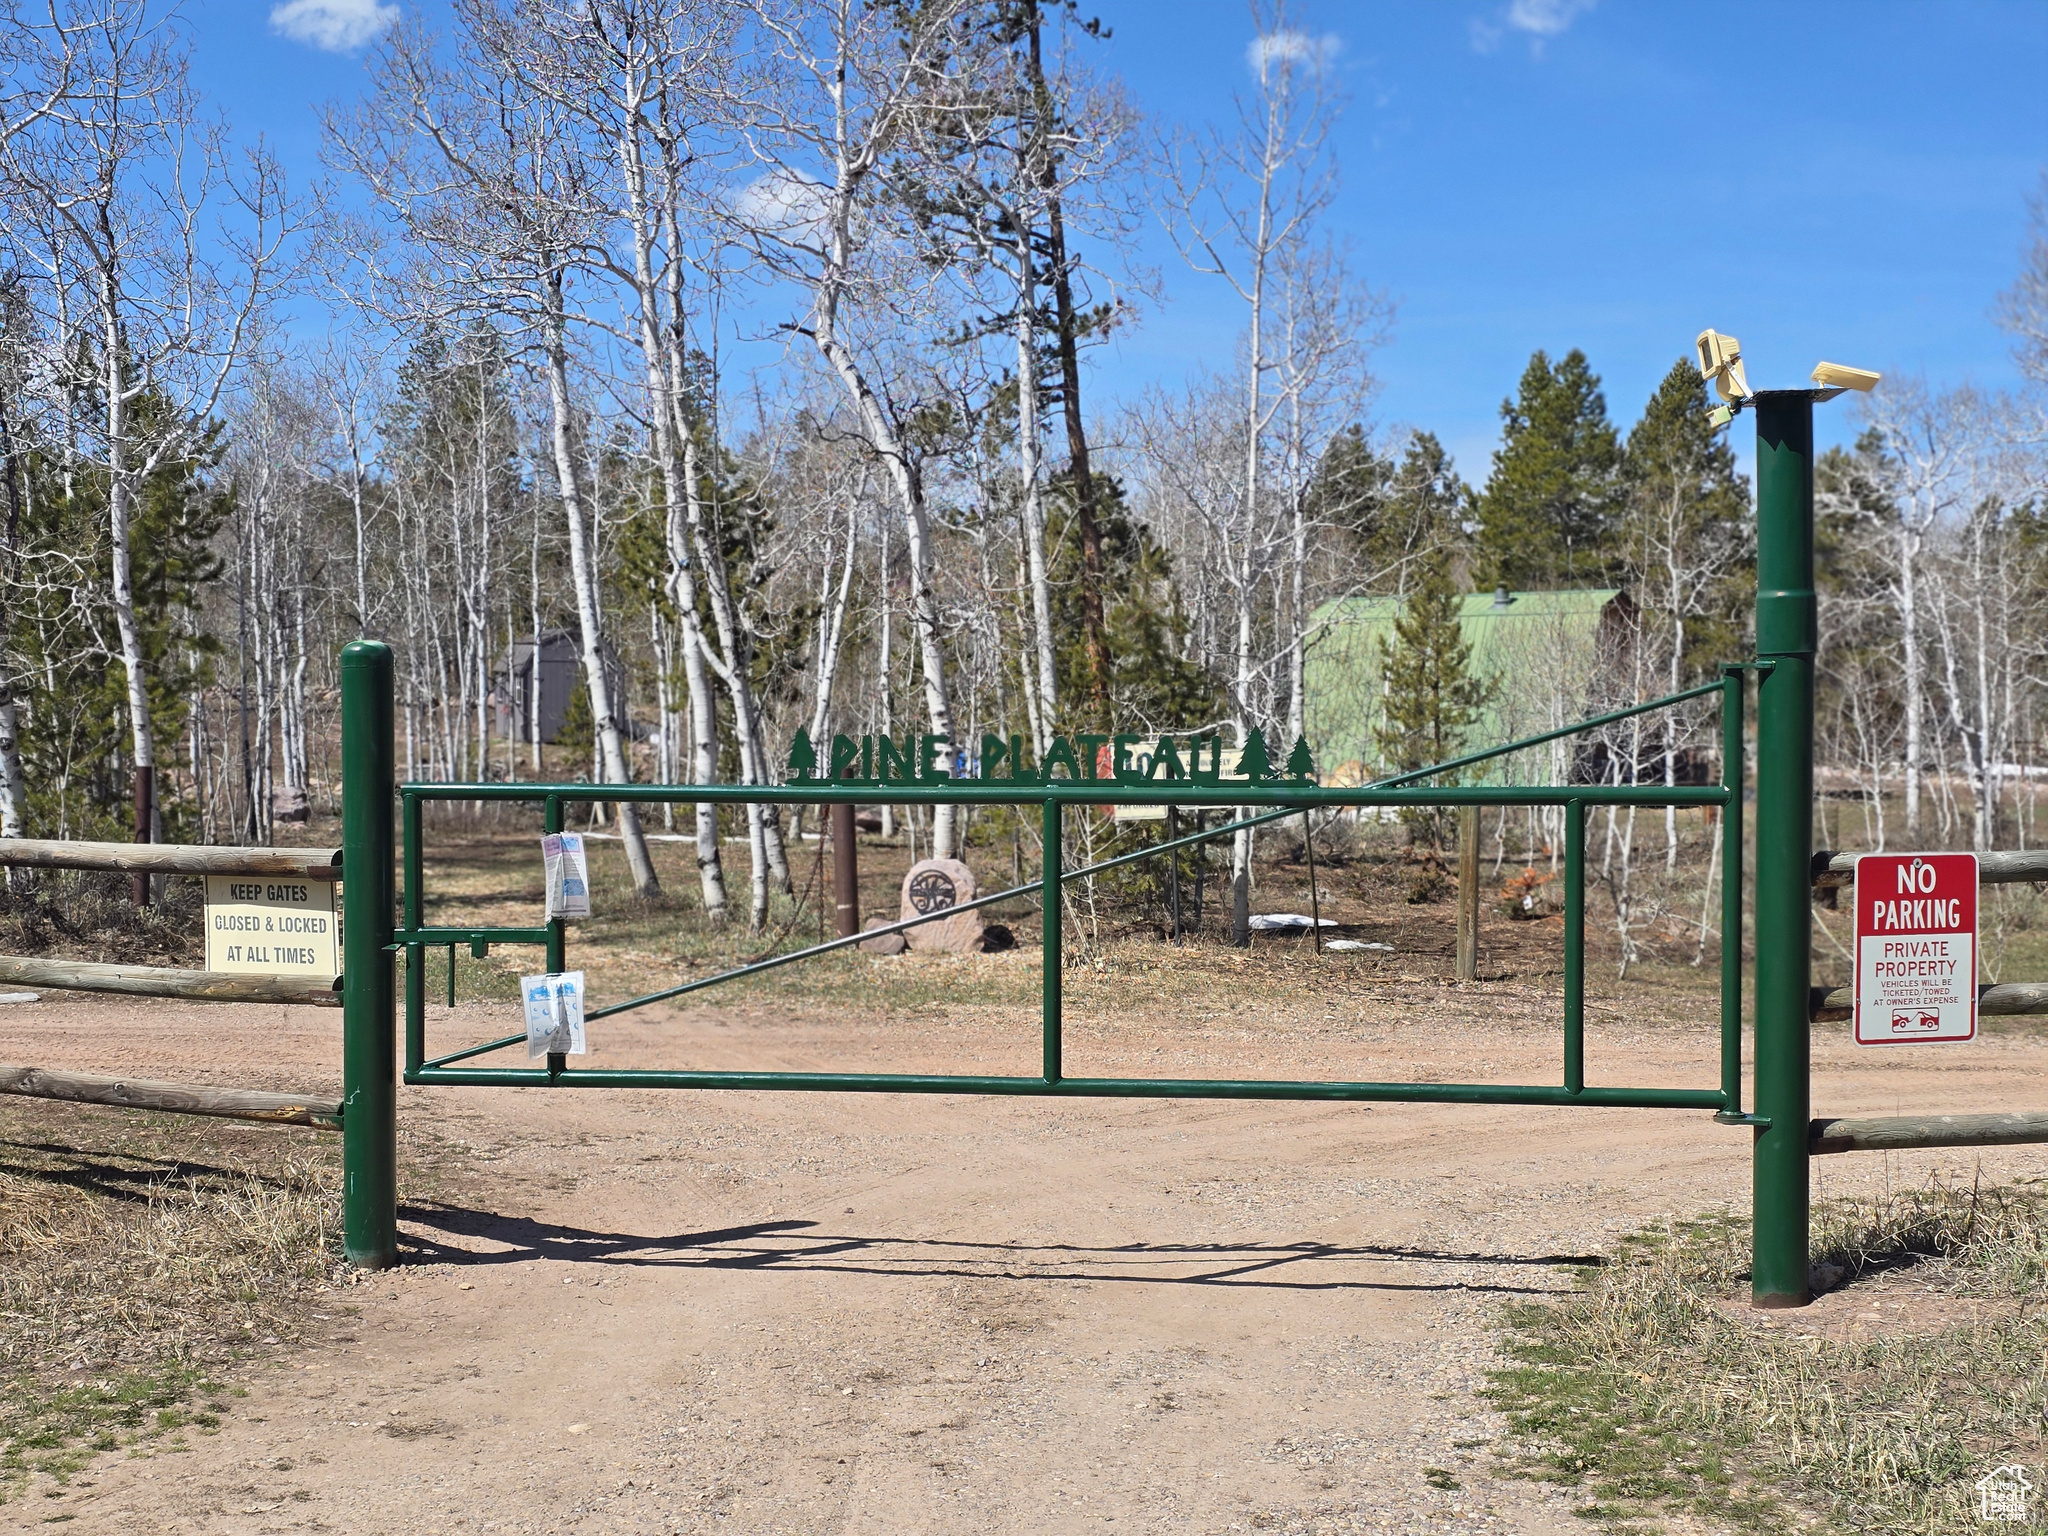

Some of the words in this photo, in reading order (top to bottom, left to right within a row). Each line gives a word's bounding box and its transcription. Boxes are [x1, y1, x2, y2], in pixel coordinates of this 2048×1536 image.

[832, 733, 950, 780] PINE
[980, 733, 1222, 780] PLATEAU
[1897, 863, 1936, 894] NO
[230, 883, 262, 901] KEEP
[267, 884, 308, 902] GATES
[1873, 898, 1960, 930] PARKING
[214, 914, 260, 931] CLOSED
[265, 916, 274, 932] &
[278, 916, 327, 933] LOCKED
[227, 946, 242, 962] AT
[246, 946, 270, 963] ALL
[274, 947, 315, 964] TIMES
[1884, 941, 1949, 958] PRIVATE
[1875, 960, 1957, 978] PROPERTY
[1880, 980, 1919, 988] VEHICLES
[1921, 979, 1939, 987] WILL
[1882, 987, 1950, 997] TICKETED/TOWED
[1886, 997, 1921, 1006] OWNER'S
[1923, 996, 1959, 1005] EXPENSE
